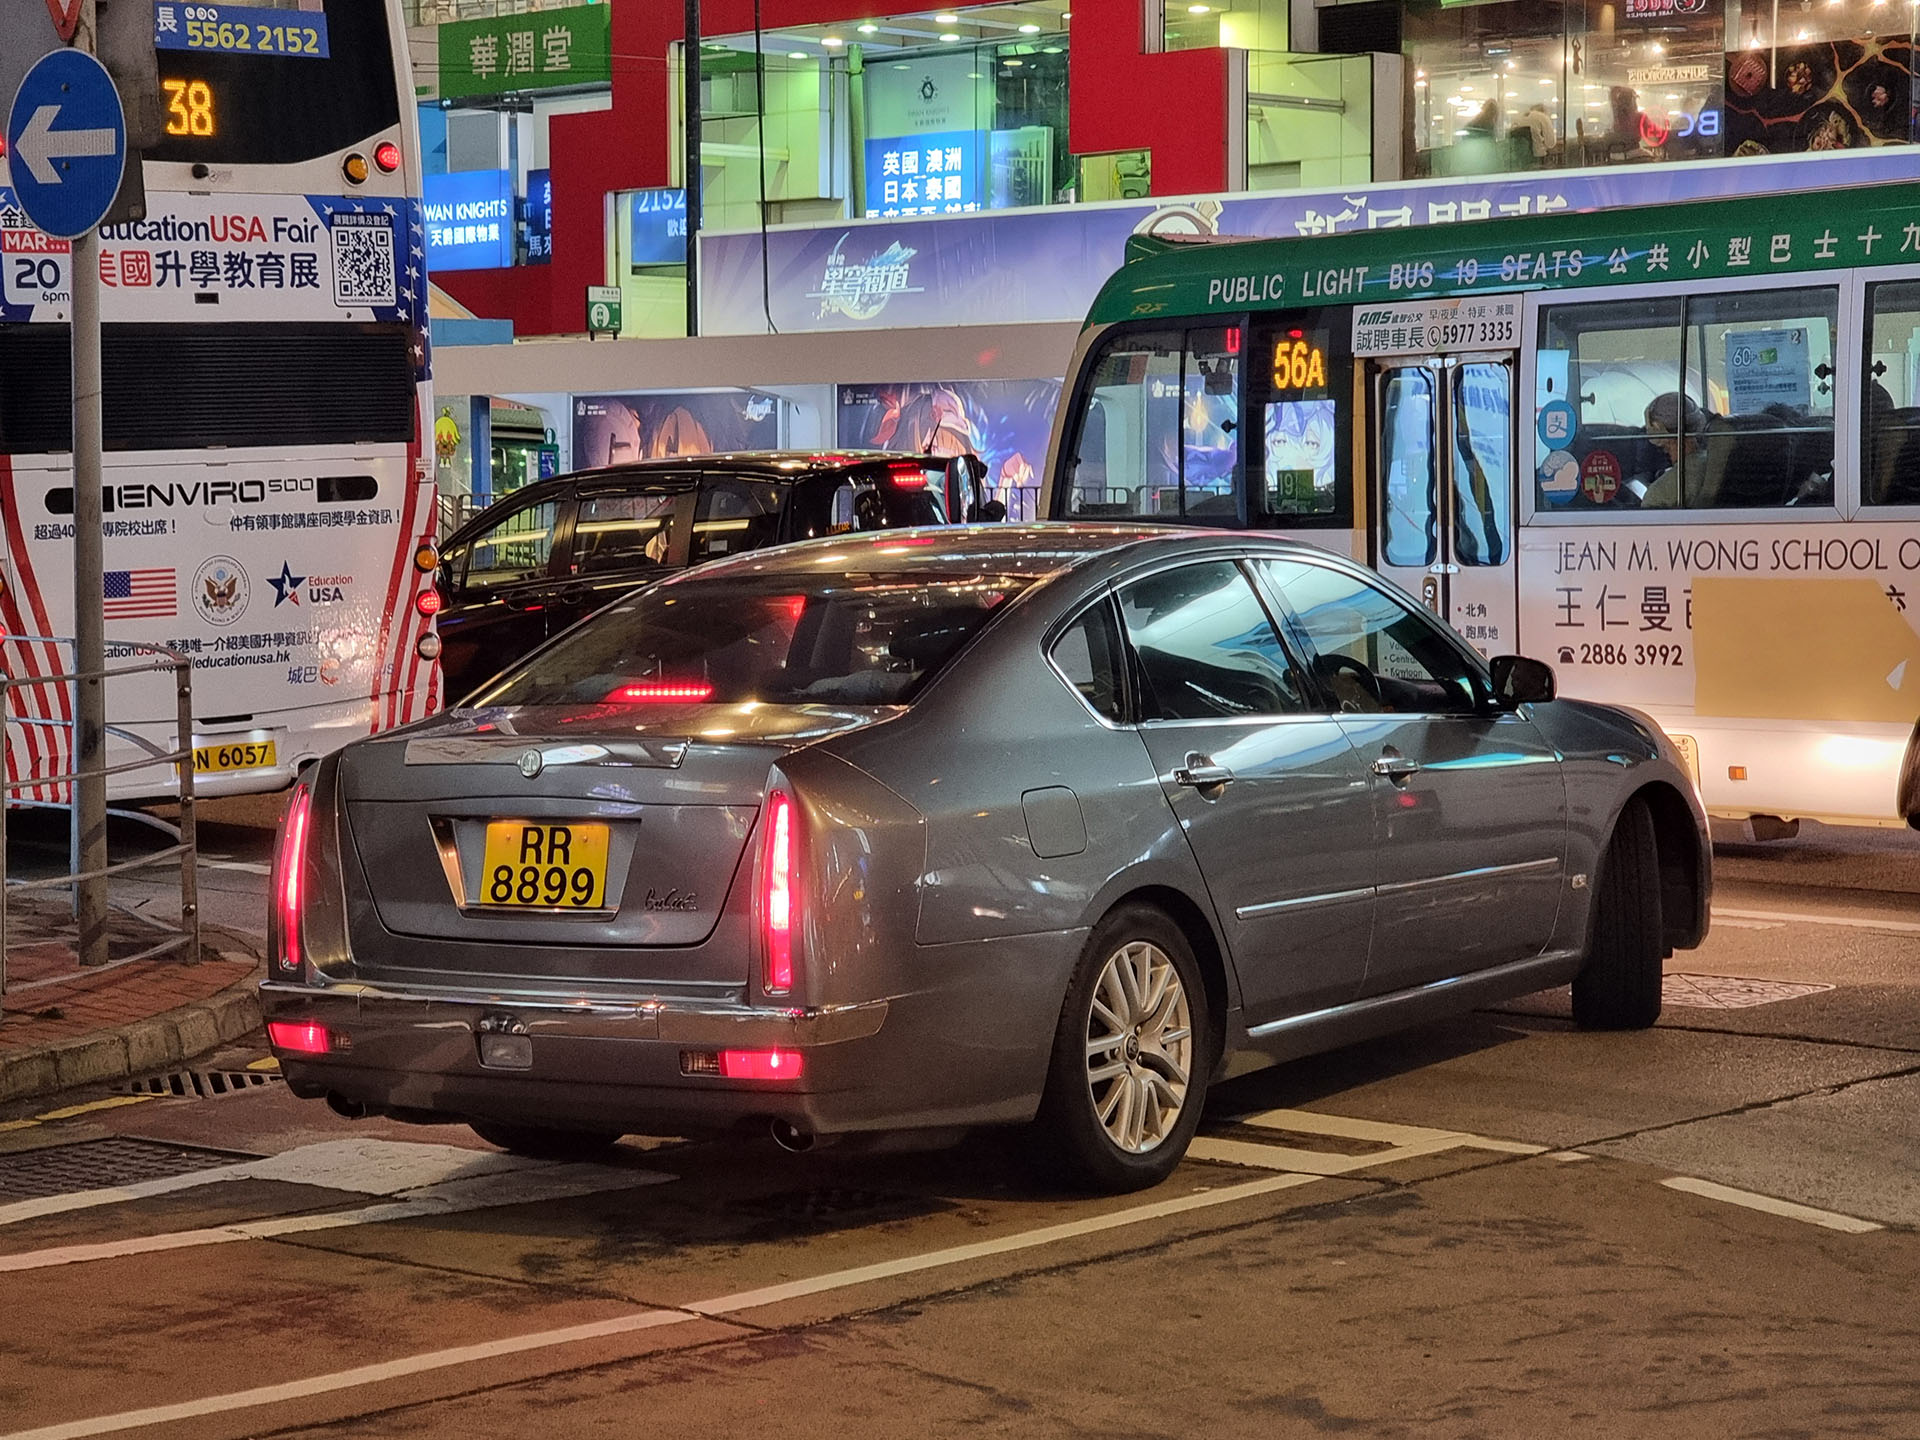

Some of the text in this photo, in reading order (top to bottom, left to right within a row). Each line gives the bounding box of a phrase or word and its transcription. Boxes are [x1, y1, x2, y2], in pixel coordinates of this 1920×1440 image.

[187, 22, 319, 53] 5562 2152
[470, 25, 571, 80] 華潤堂
[164, 80, 213, 135] 38
[883, 147, 962, 176] 英國 澳洲
[884, 175, 962, 203] 日本 泰國
[456, 200, 507, 220] KNIGHTS
[99, 215, 319, 243] ducationUSA Fair
[4, 232, 48, 251] MAR
[15, 258, 60, 289] 20
[1208, 250, 1583, 304] PUBLIC LIGHT BUS 19 SEATS
[42, 291, 70, 304] 6pm
[1357, 311, 1392, 326] AMS
[1356, 327, 1425, 351] 誠聘車長
[1443, 321, 1513, 345] 5977 3335
[1274, 341, 1325, 390] 56A
[1732, 346, 1753, 367] 60
[116, 478, 314, 509] ENVIRO 500
[1278, 473, 1294, 496] 19
[1554, 541, 1616, 575] JEAN
[1627, 541, 1658, 571] M.
[1667, 540, 1759, 571] WONG
[1770, 539, 1888, 570] SCHOOL
[308, 575, 353, 587] Education
[309, 587, 344, 603] USA
[1465, 603, 1487, 618] 北角
[1465, 625, 1499, 640] 跑馬地
[1580, 643, 1683, 666] 2886 3992
[287, 666, 318, 684] 城巴
[218, 744, 268, 767] 6057
[519, 827, 572, 865] RR
[490, 865, 594, 906] 8899
